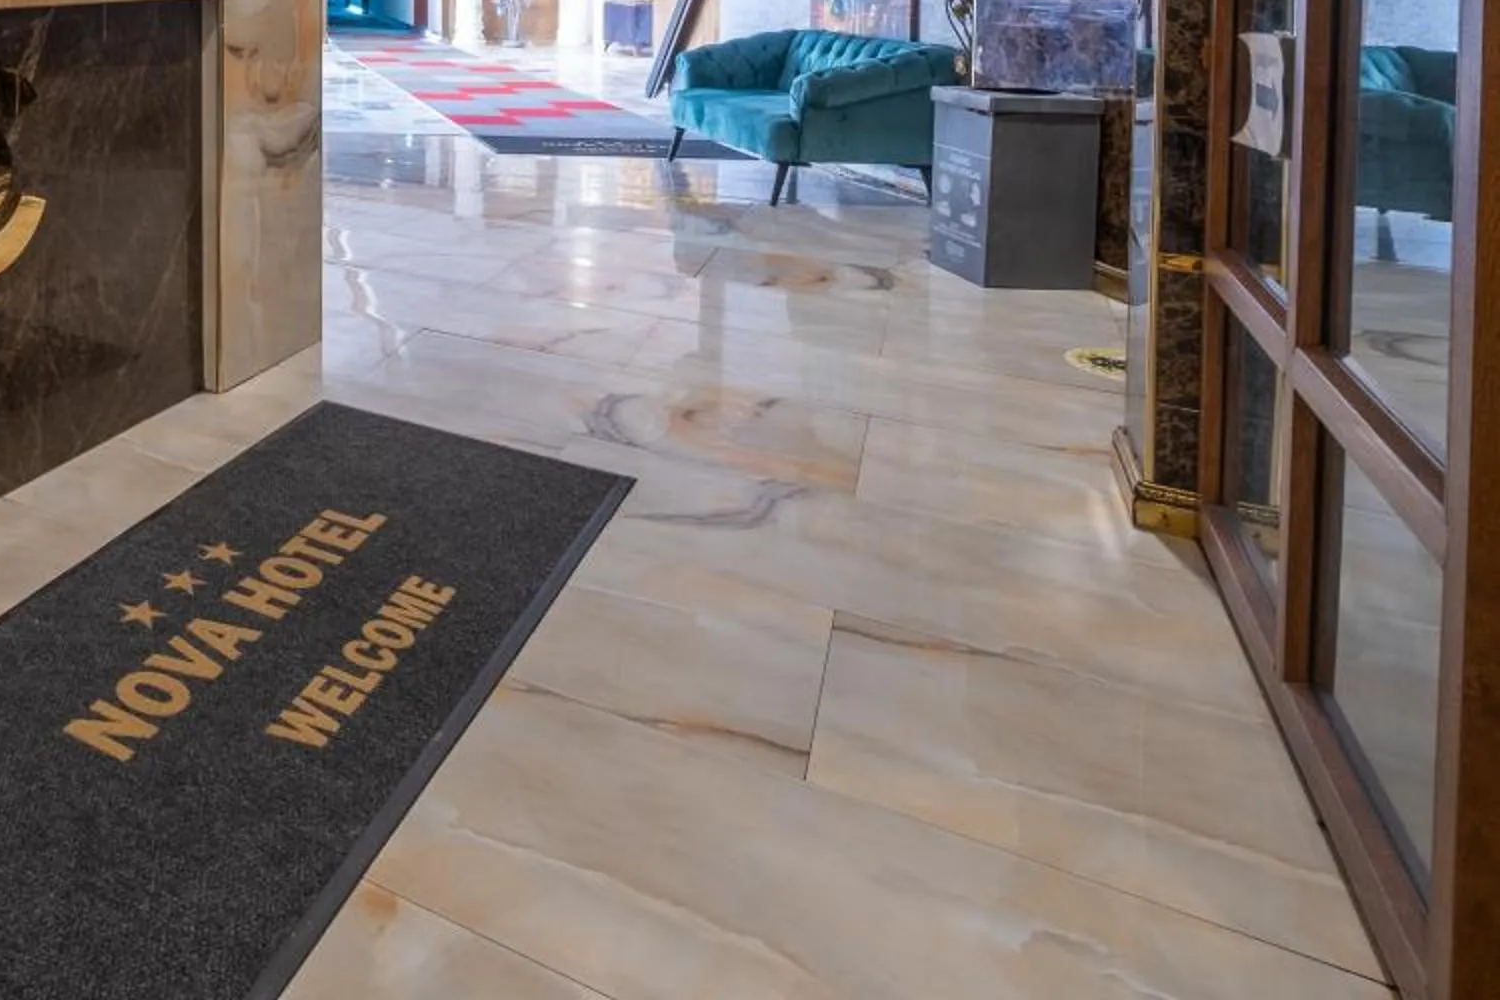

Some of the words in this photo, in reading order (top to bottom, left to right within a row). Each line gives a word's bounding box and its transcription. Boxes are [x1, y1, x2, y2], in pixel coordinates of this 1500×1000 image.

[63, 617, 264, 763] NOVA
[221, 508, 389, 621] HOTEL
[265, 574, 458, 749] WELCOME
